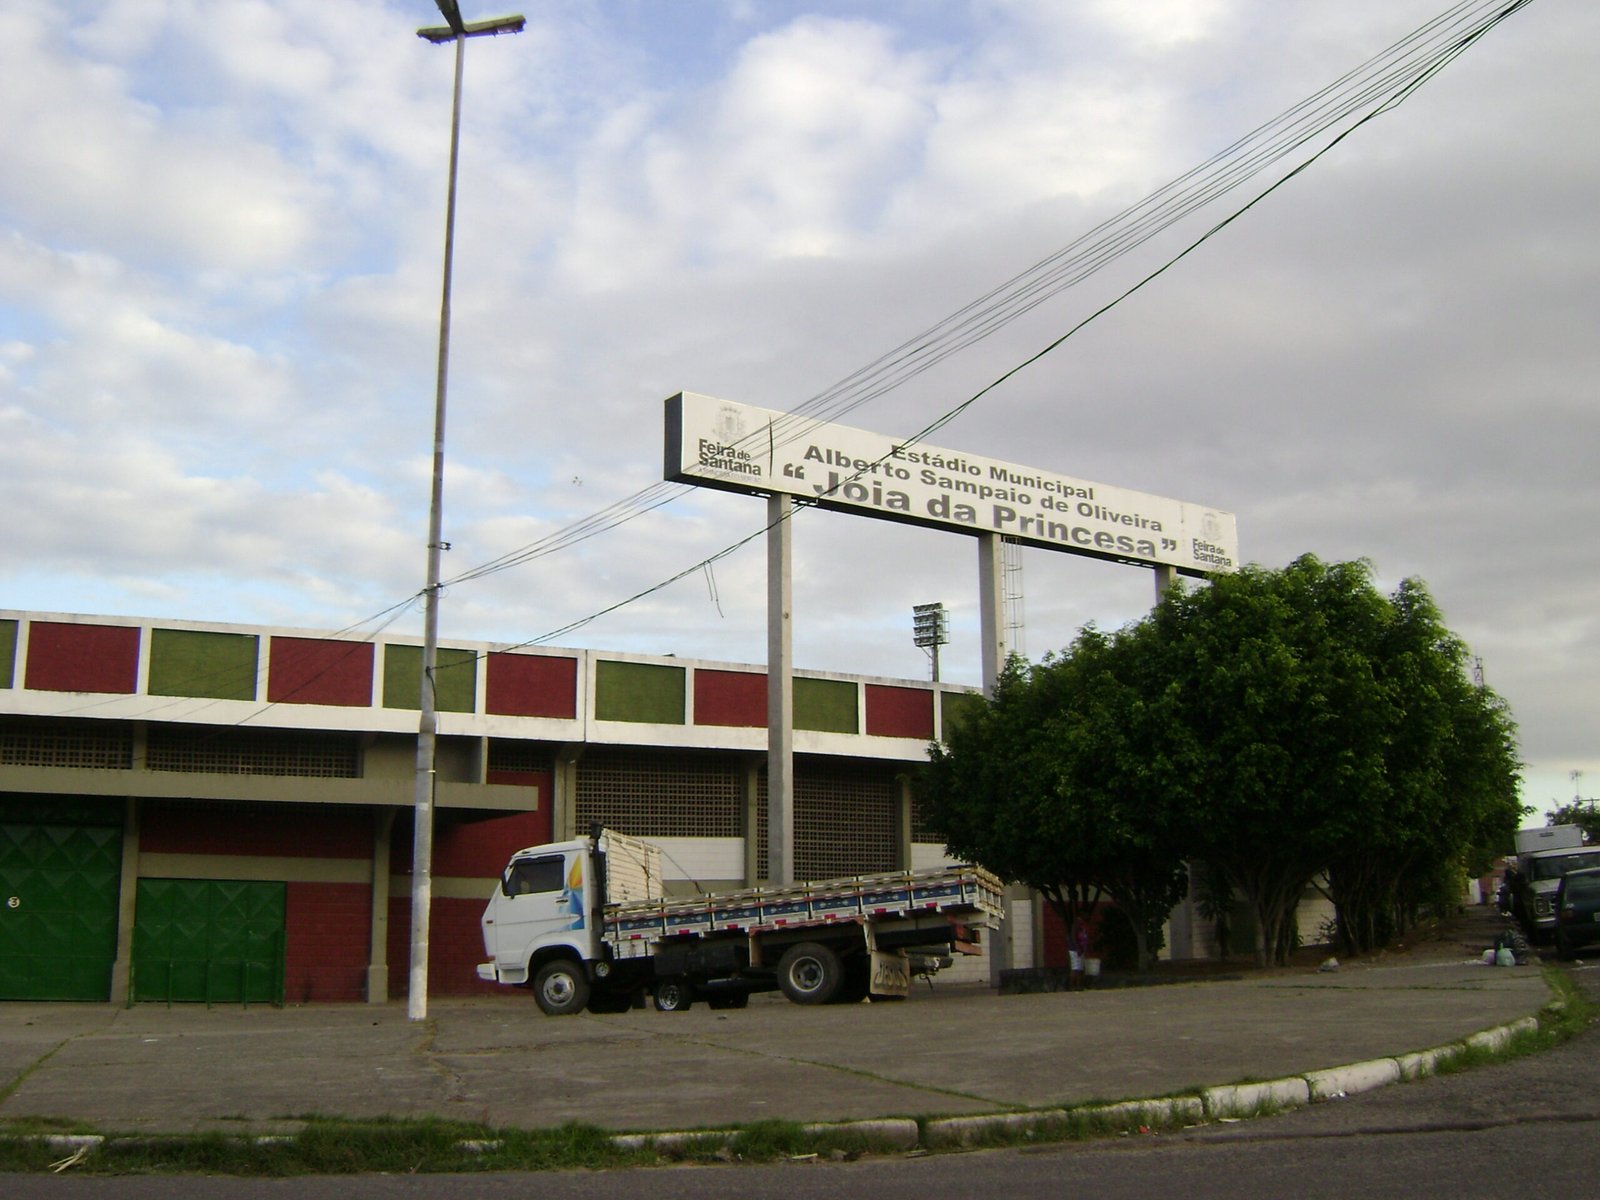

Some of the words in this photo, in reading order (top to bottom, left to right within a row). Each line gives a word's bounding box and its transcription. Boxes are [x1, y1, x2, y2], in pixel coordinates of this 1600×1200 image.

[699, 438, 736, 459] Feira
[737, 450, 751, 461] de
[699, 451, 761, 476] Santana
[891, 444, 981, 477] Estádio
[990, 466, 1094, 500] Municipal
[803, 445, 911, 480] Alberto
[920, 476, 1032, 505] Sampaio
[1040, 495, 1069, 513] de
[1076, 502, 1163, 532] Oliveira
[926, 494, 977, 525] da
[1192, 537, 1216, 553] Feira
[1216, 546, 1225, 556] de
[1193, 549, 1232, 567] Santana
